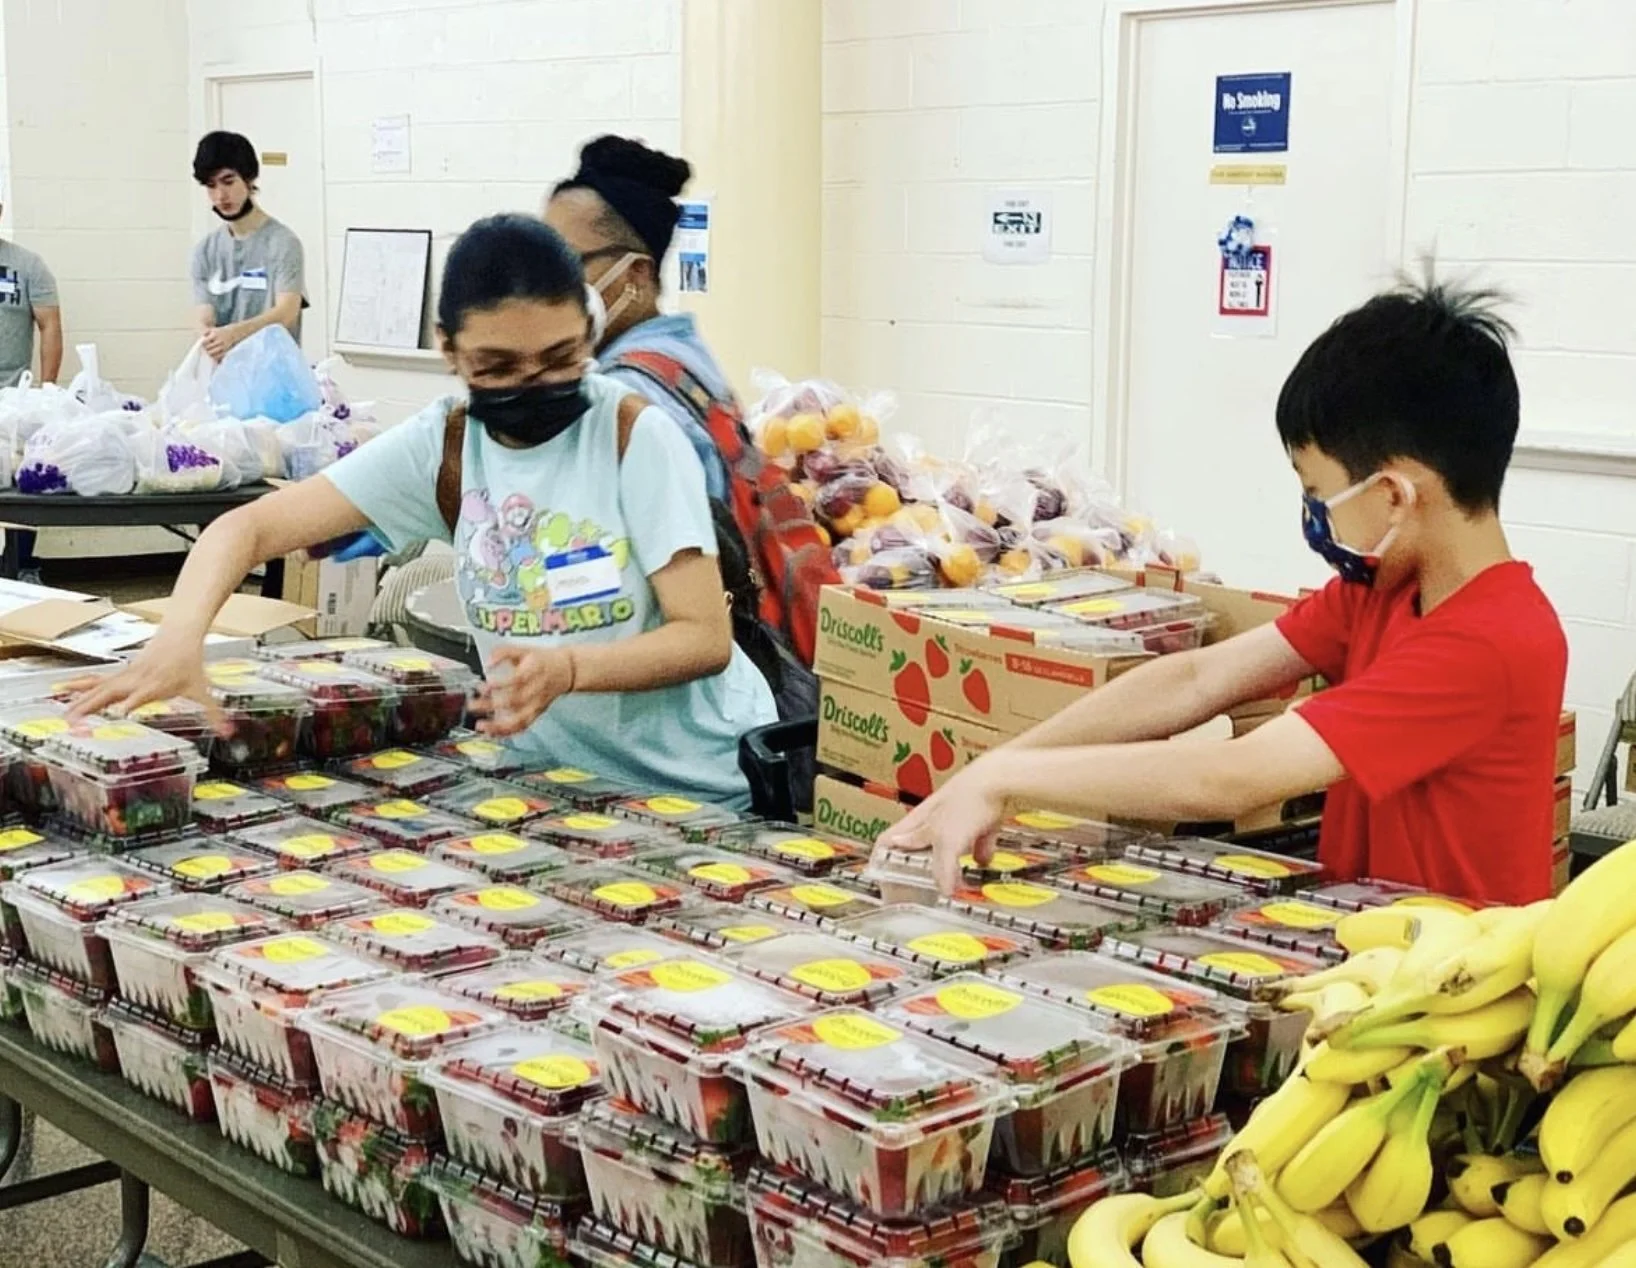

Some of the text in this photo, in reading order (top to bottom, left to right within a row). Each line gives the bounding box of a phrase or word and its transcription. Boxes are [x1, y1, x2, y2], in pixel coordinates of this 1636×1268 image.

[1222, 90, 1281, 111] No Smoking
[542, 599, 633, 634] MARIO
[821, 607, 883, 652] Driscoll's
[824, 695, 889, 742] Driscoll's
